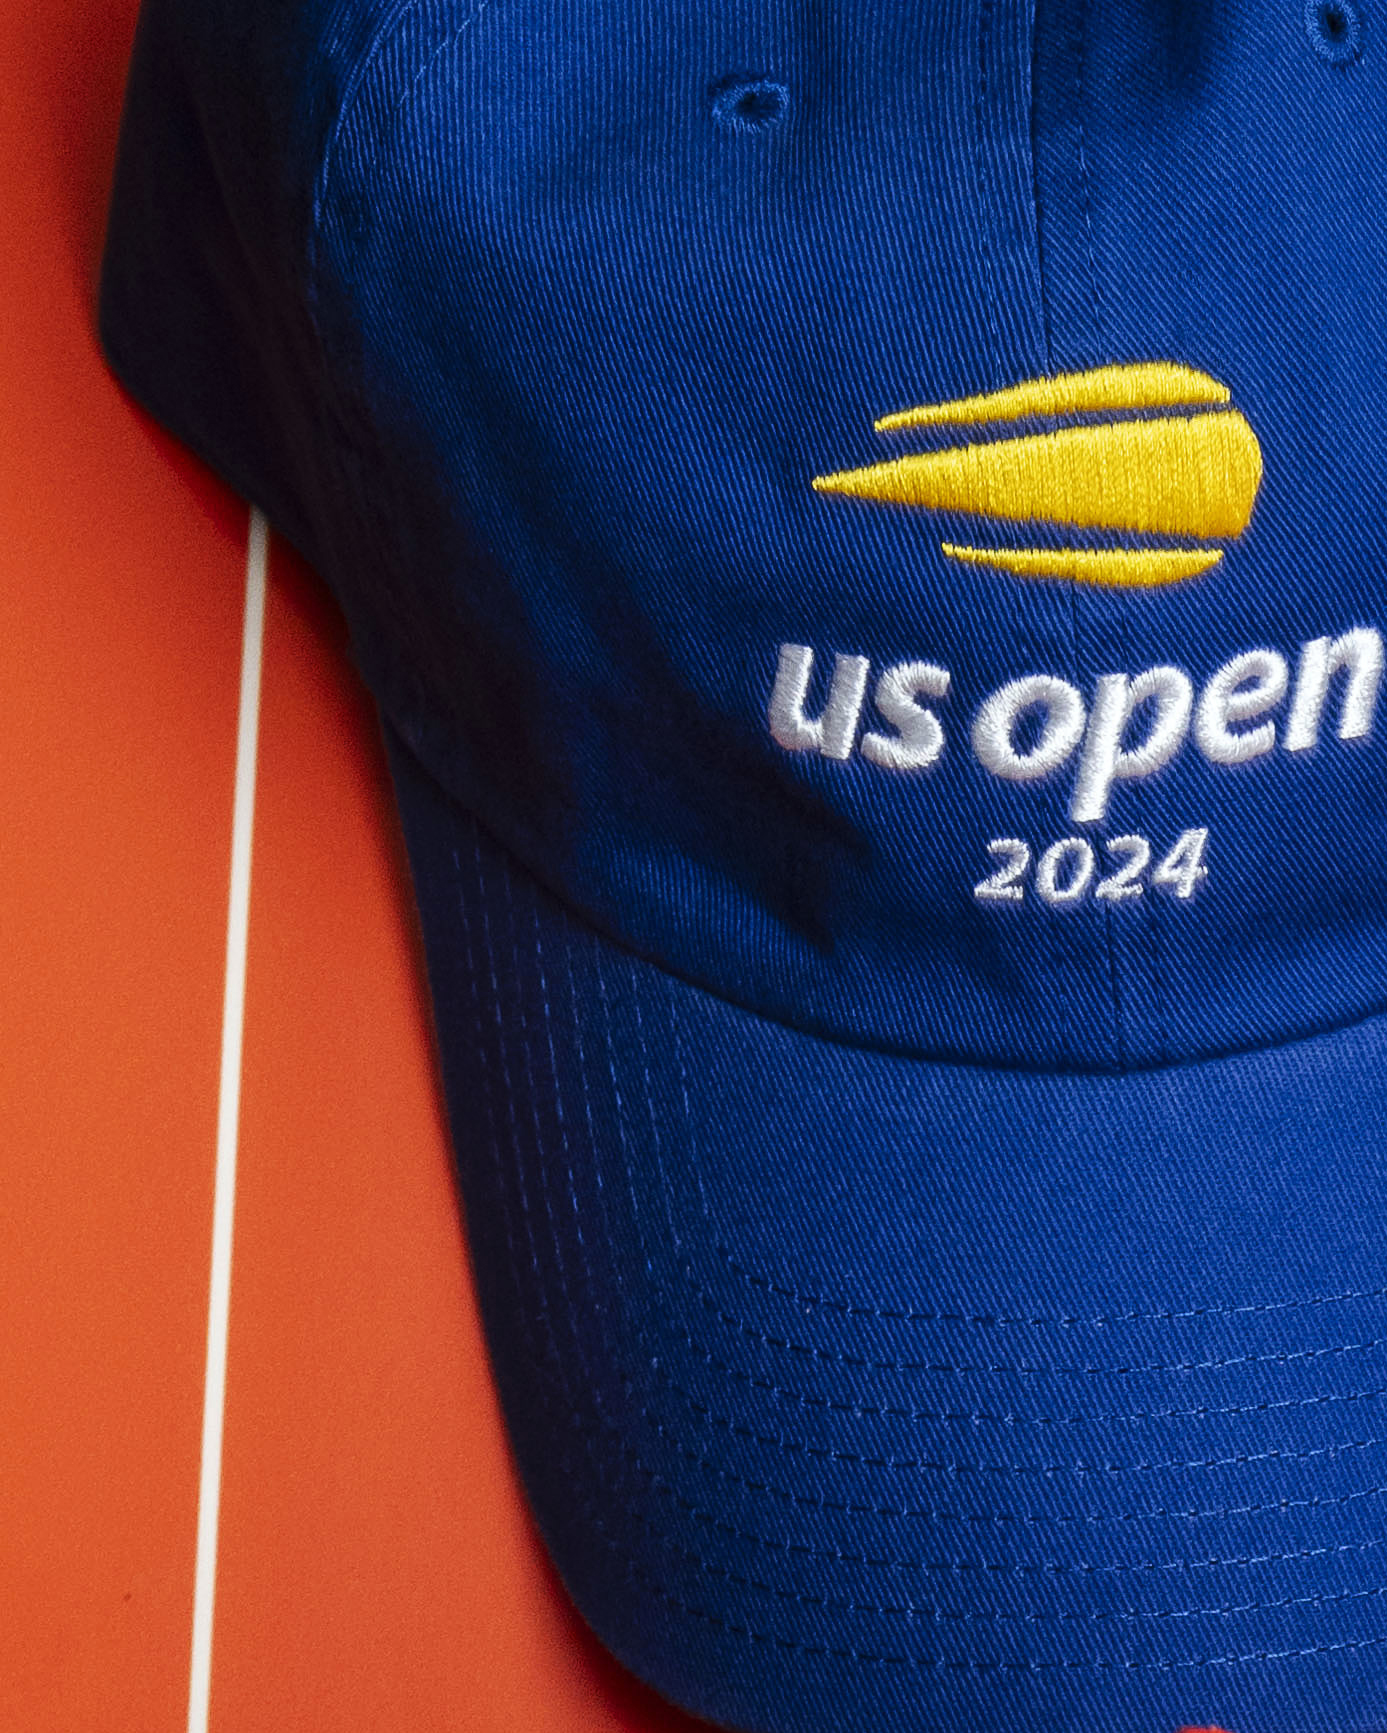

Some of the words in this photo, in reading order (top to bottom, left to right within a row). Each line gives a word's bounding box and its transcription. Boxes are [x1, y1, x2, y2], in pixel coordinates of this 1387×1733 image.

[768, 642, 951, 769] us
[972, 626, 1386, 822] open
[973, 828, 1208, 901] 2024
